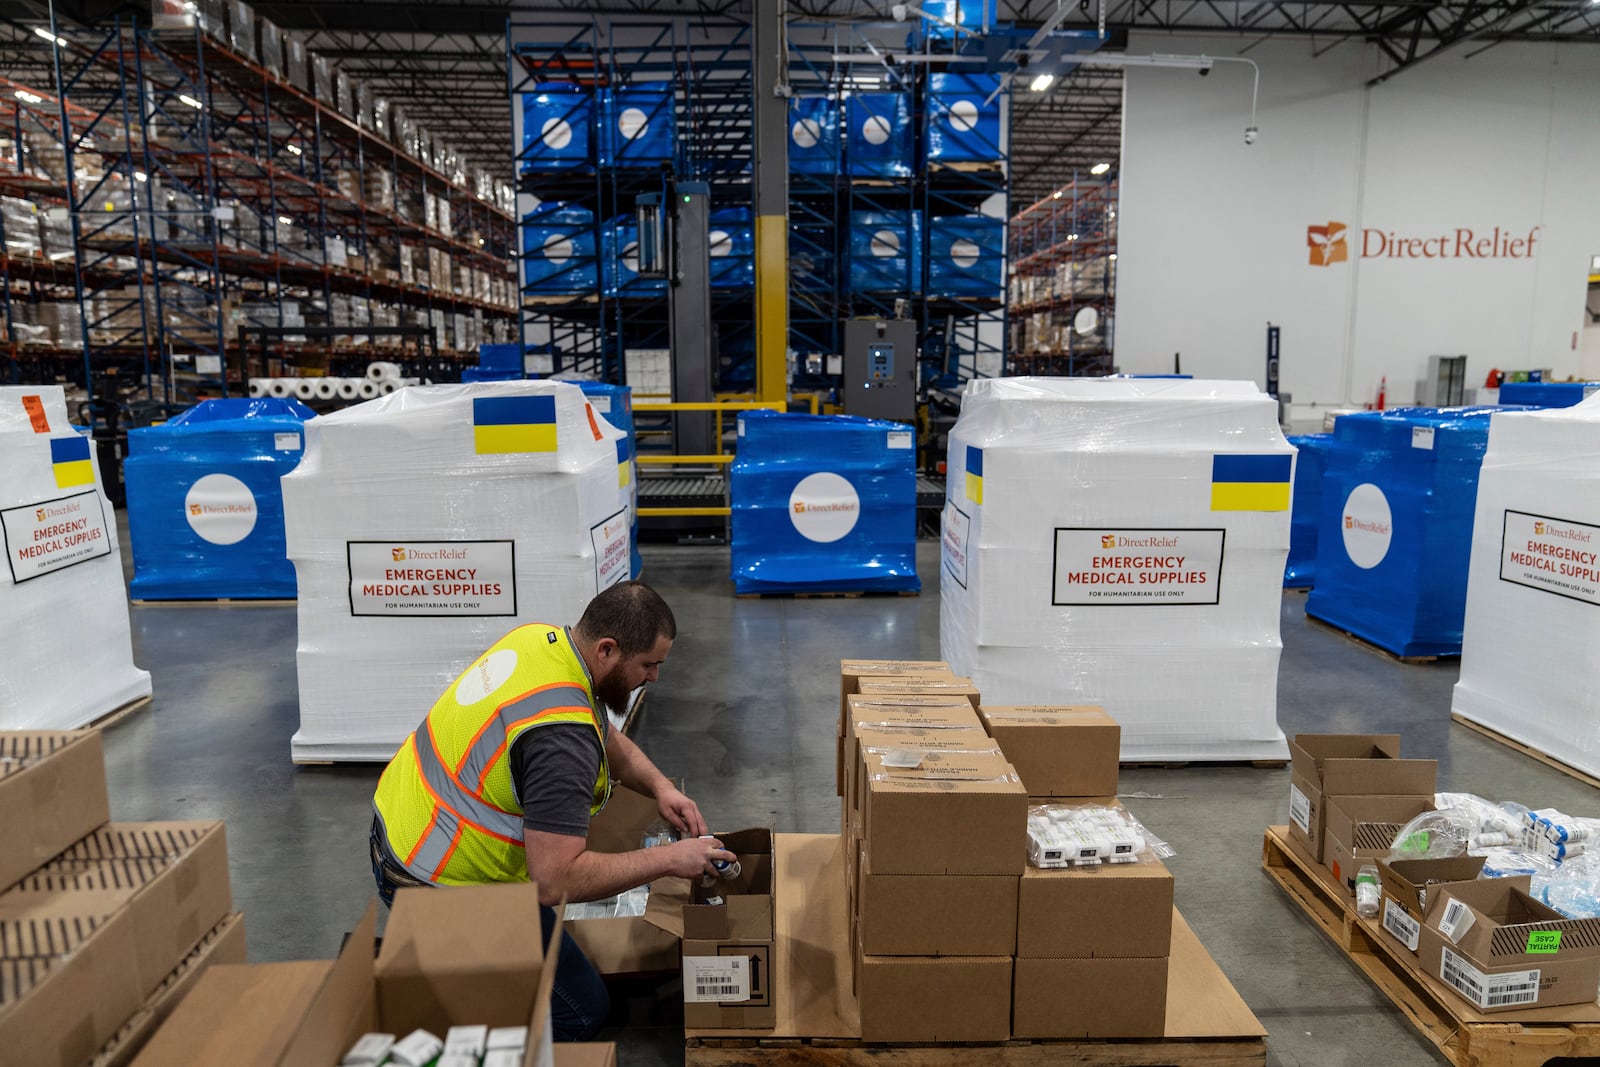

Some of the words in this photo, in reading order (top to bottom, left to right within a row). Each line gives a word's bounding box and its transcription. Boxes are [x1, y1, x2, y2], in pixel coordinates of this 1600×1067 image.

[34, 518, 87, 541] EMERGENCY
[19, 540, 63, 560] MEDICAL
[64, 528, 101, 548] SUPPLIES
[1528, 540, 1597, 565] EMERGENCY
[1092, 557, 1186, 568] EMERGENCY
[1511, 552, 1556, 572] MEDICAL
[1560, 563, 1600, 583] SUPPLI
[385, 569, 476, 580] EMERGENCY
[1068, 572, 1134, 584] MEDICAL
[1139, 572, 1206, 583] SUPPLIES
[1534, 575, 1569, 588] HUMANITARIAN
[363, 585, 429, 596] MEDICAL
[433, 584, 501, 595] SUPPLIES
